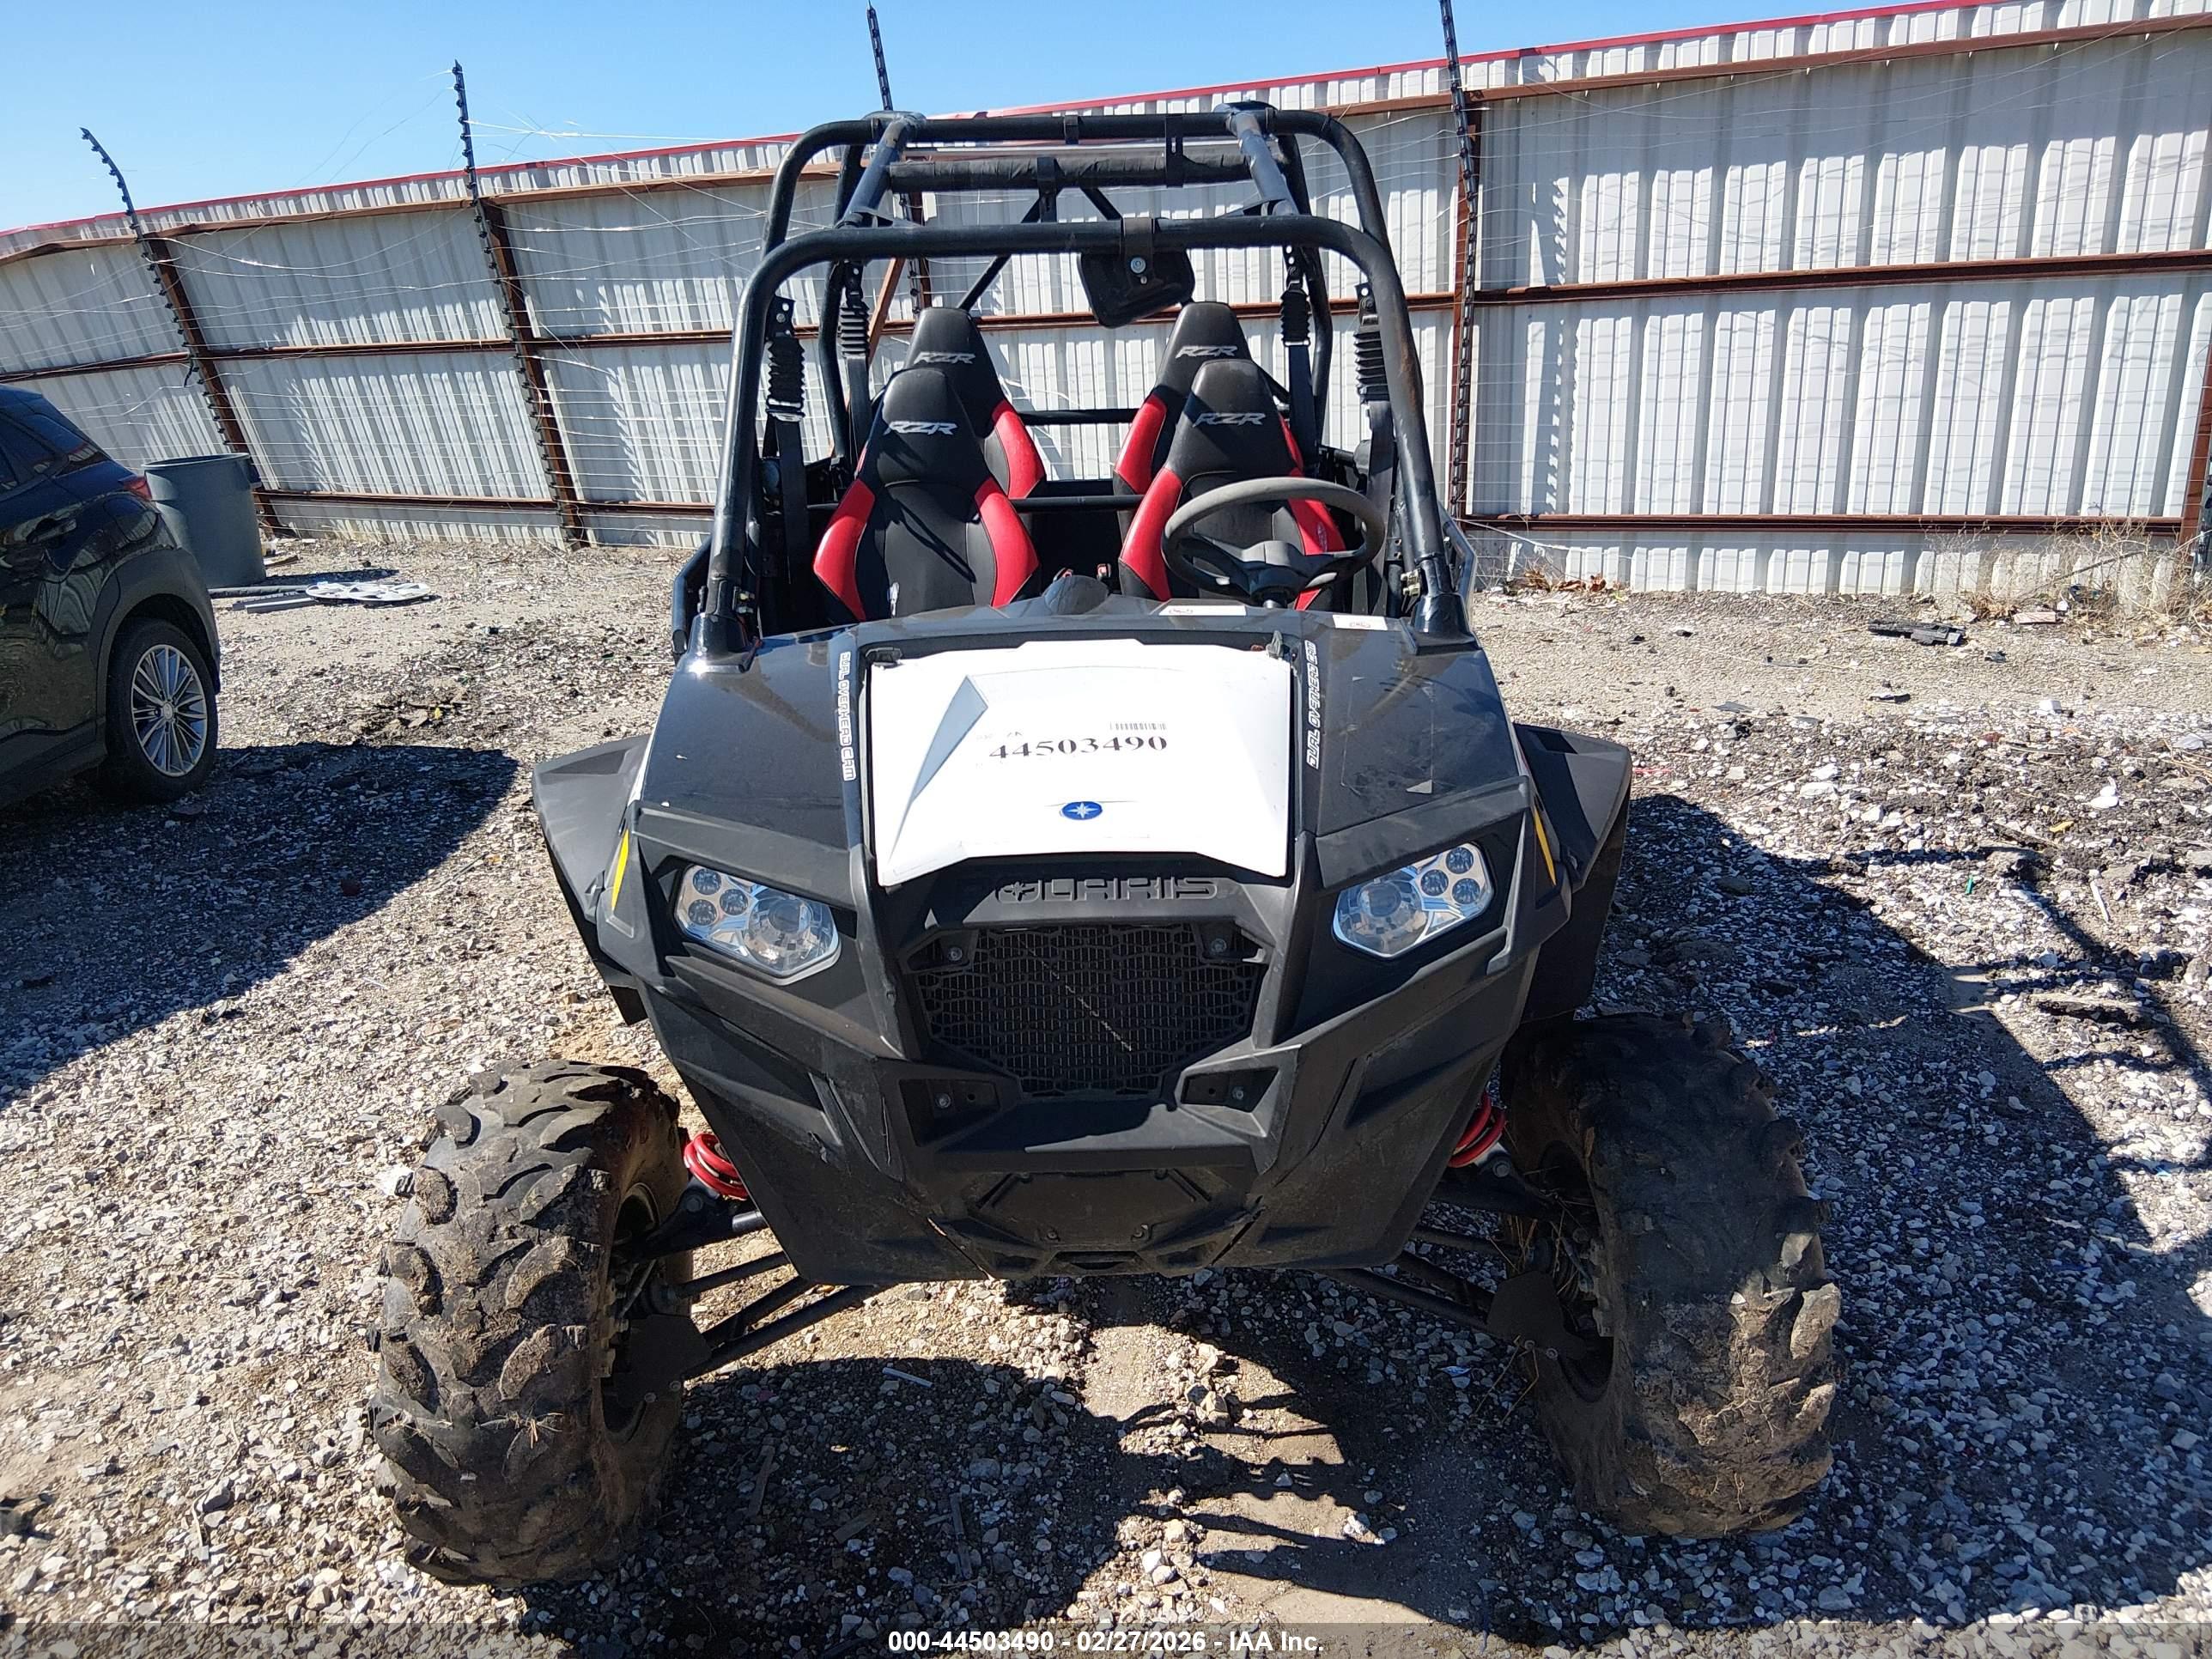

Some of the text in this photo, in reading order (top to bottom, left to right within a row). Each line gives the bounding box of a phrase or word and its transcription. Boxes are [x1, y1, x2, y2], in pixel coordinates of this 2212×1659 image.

[914, 351, 976, 365] RZR
[1175, 345, 1238, 359] RZR
[884, 420, 958, 435] RZR
[1192, 412, 1267, 428] RZR
[1304, 640, 1318, 665] CAM
[838, 651, 851, 680] DUAL
[988, 736, 1167, 758] 44503490
[1306, 729, 1321, 770] DUAL
[841, 746, 857, 781] CAM
[994, 876, 1218, 904] OLARIS
